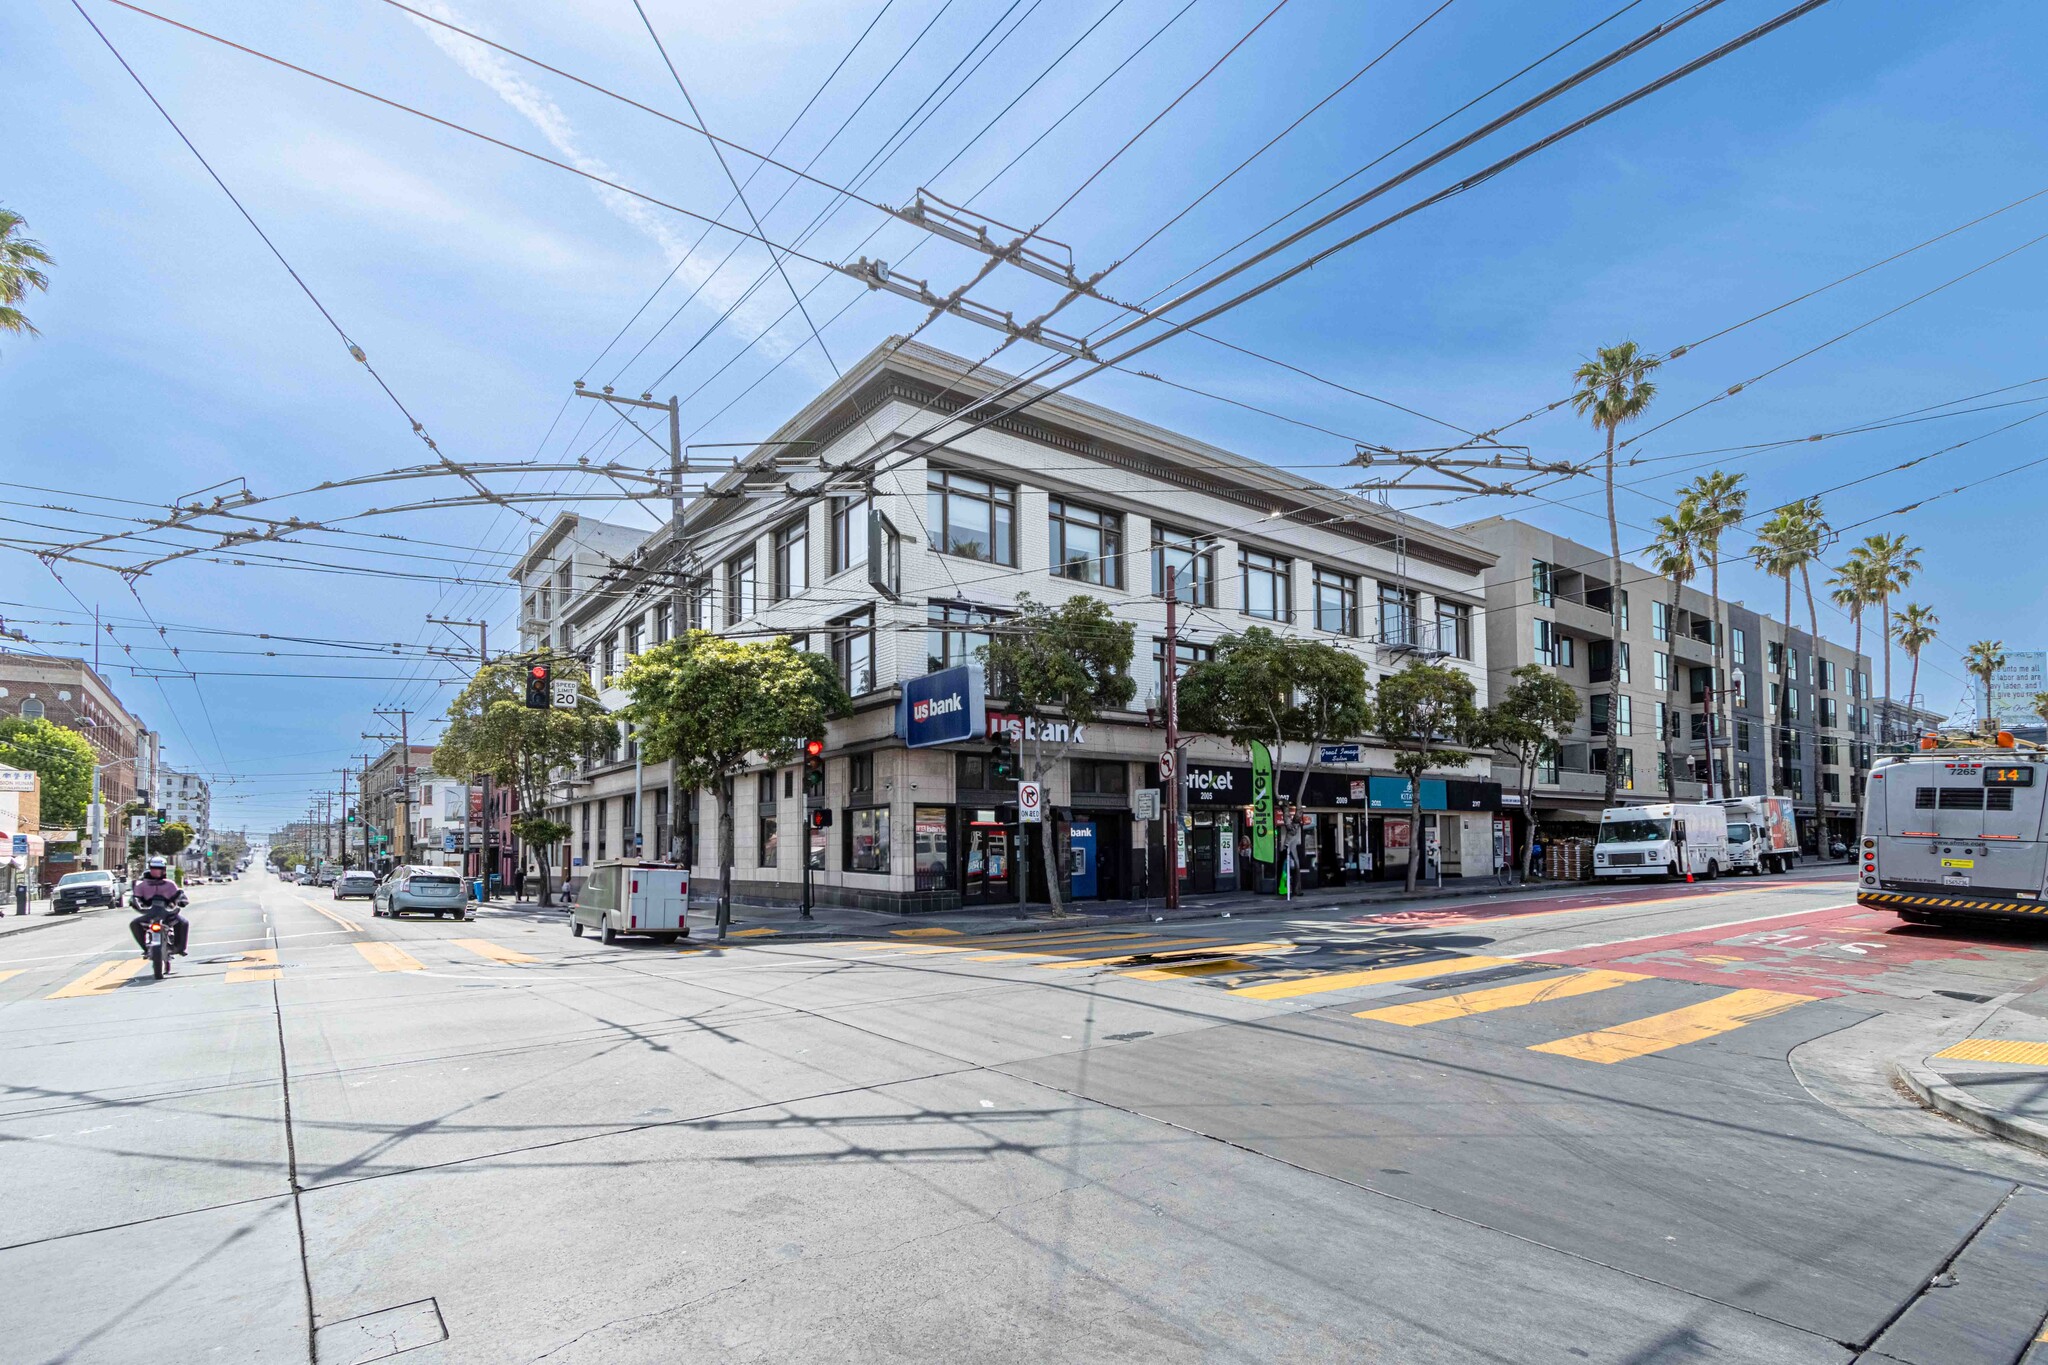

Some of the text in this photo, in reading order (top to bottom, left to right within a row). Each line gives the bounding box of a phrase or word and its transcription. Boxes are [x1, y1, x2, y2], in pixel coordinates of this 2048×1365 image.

[556, 694, 575, 704] 20
[1950, 768, 1977, 776] 7265
[1997, 769, 2019, 781] 14
[1200, 792, 1213, 800] 2005
[1336, 796, 1348, 804] 2009
[1254, 768, 1271, 838] cricket
[1070, 828, 1092, 837] bank
